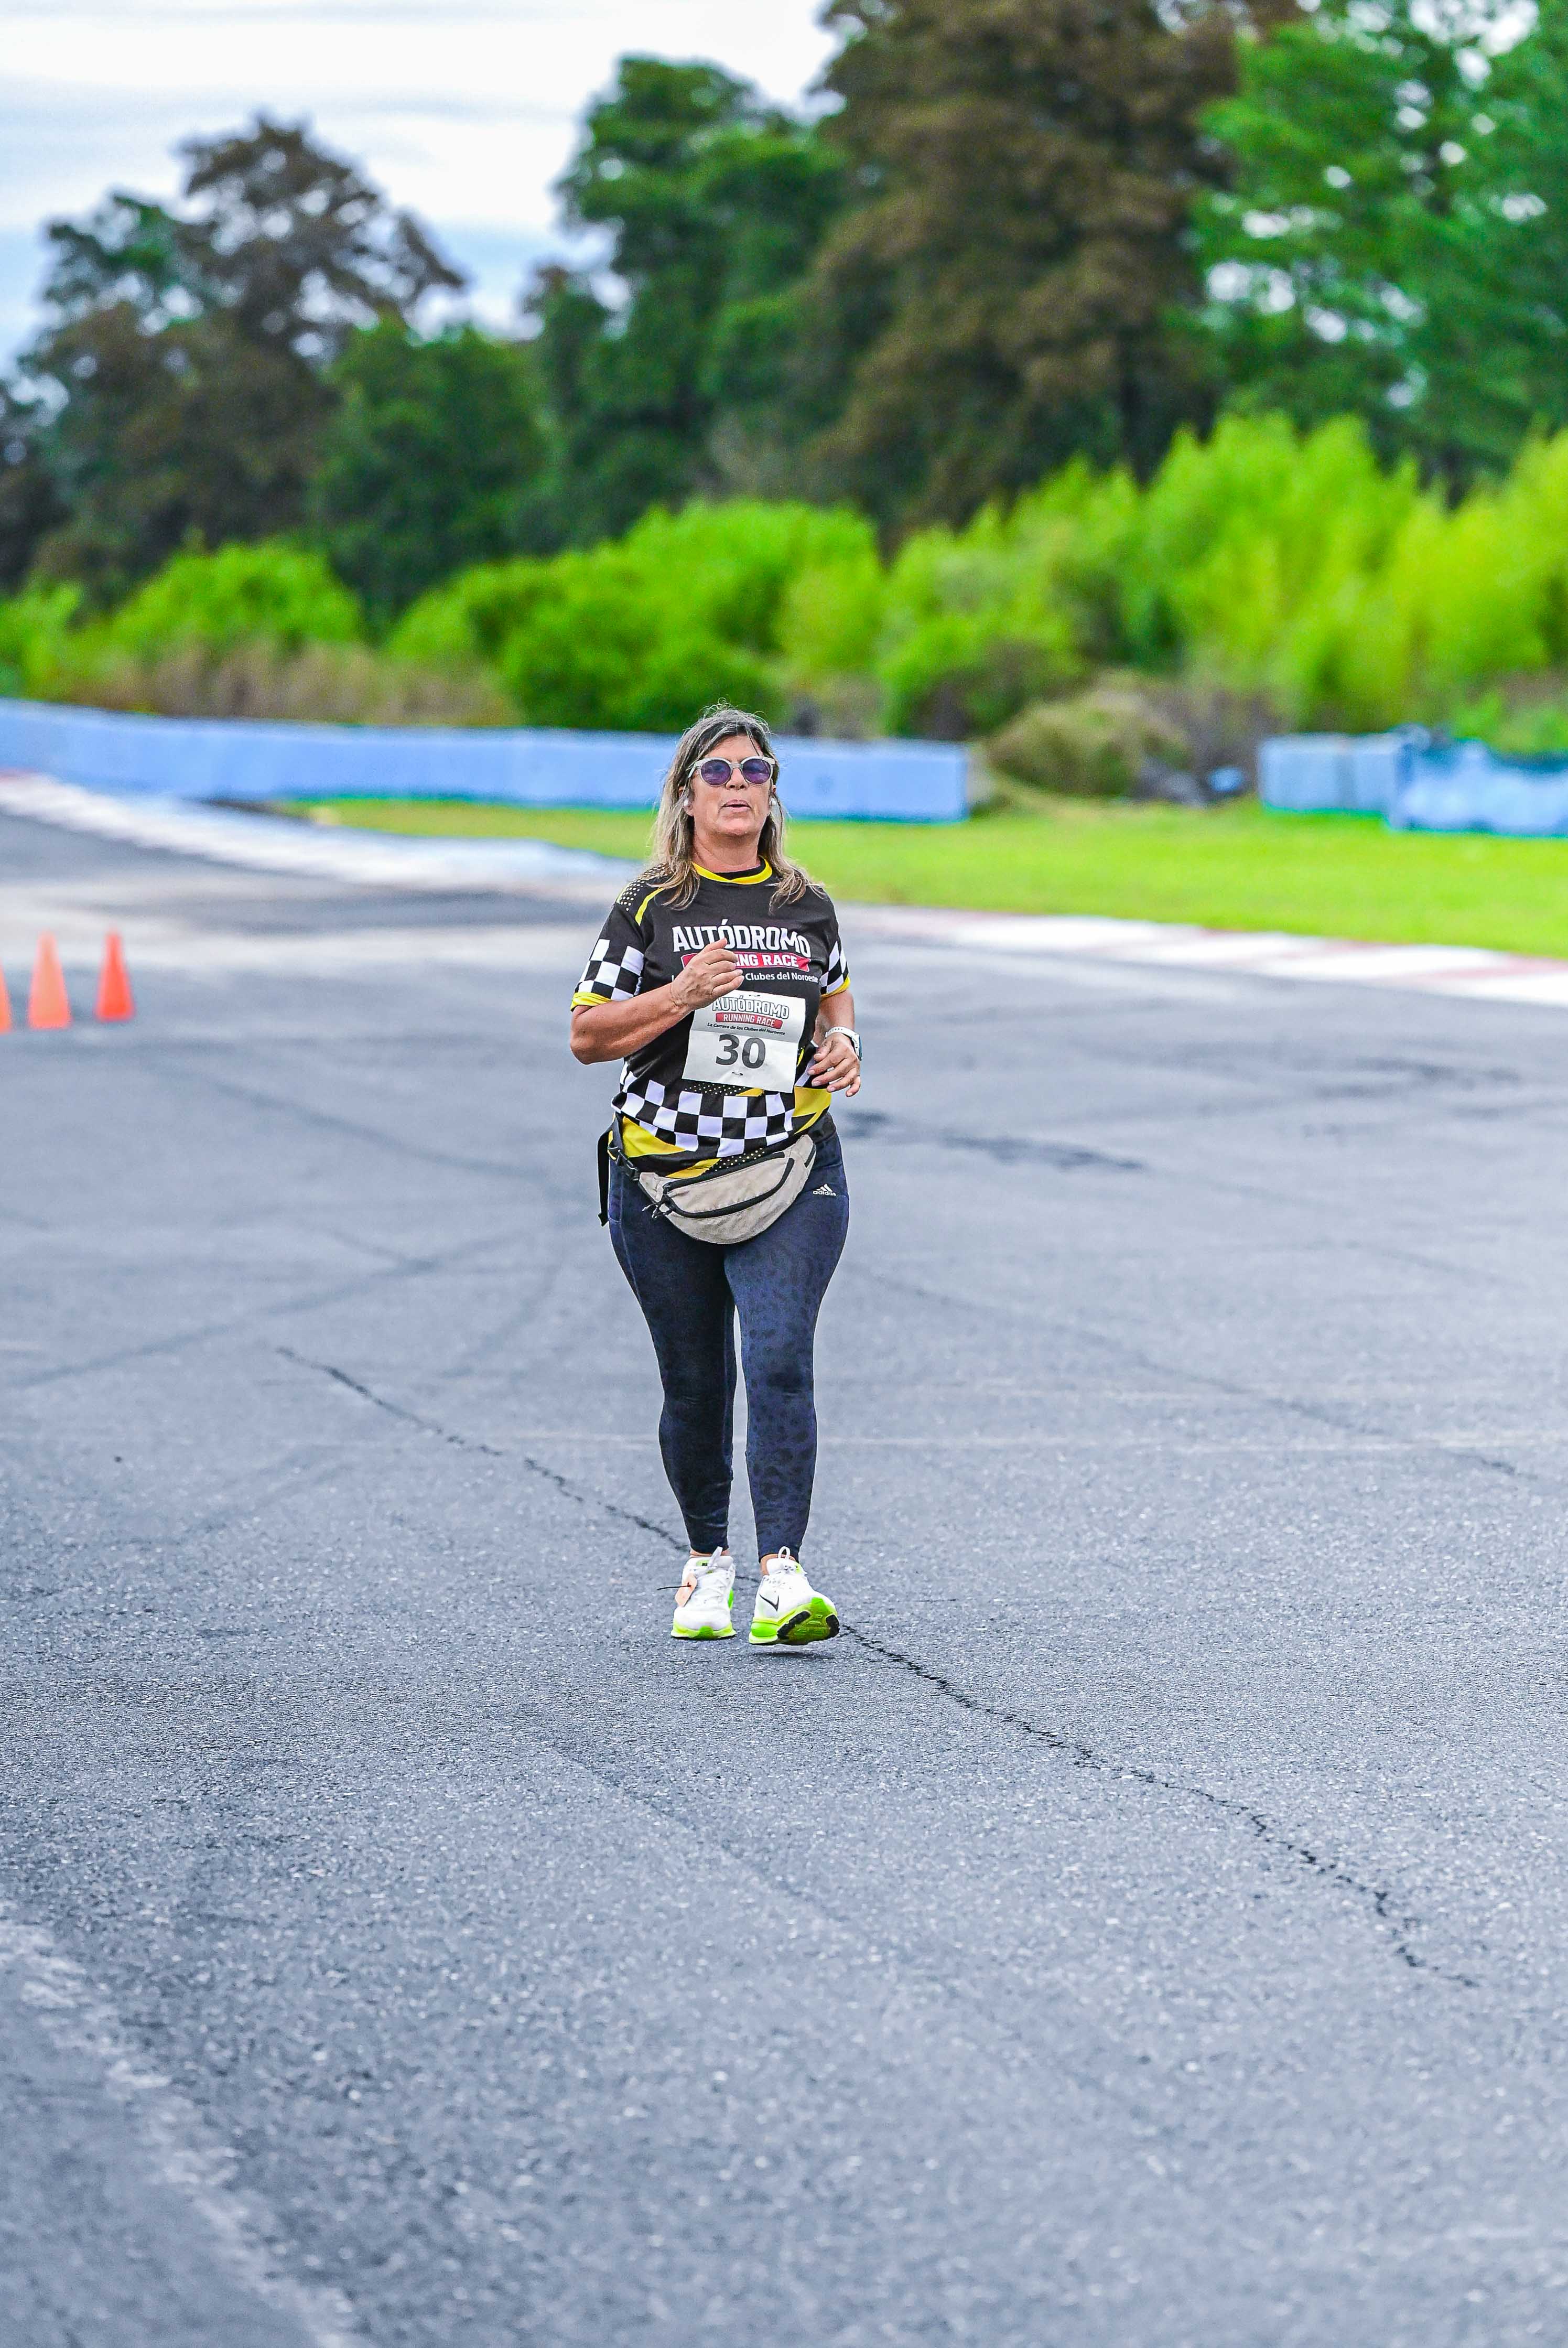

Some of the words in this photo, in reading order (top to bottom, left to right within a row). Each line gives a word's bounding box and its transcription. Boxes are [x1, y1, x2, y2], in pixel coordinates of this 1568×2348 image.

[672, 919, 811, 958] AUTÓDROMO
[762, 954, 799, 967] RACE
[745, 972, 775, 981] Clubes
[776, 972, 790, 980] del
[791, 972, 819, 983] Noroeste
[712, 995, 790, 1019] AUTÓDROMO
[723, 1013, 755, 1023] RUNNING
[756, 1016, 776, 1027] RACE
[715, 1033, 766, 1069] 30
